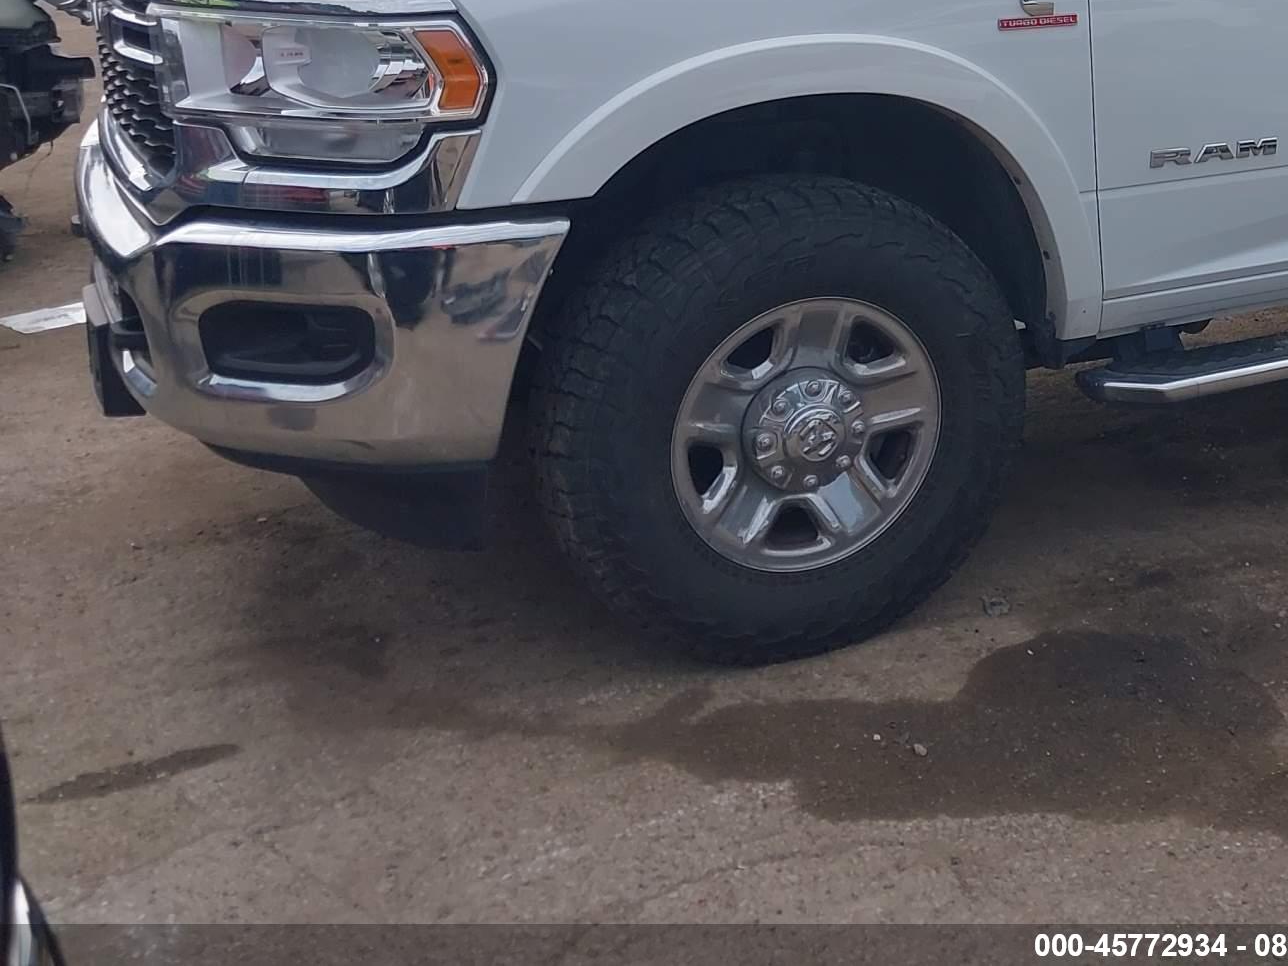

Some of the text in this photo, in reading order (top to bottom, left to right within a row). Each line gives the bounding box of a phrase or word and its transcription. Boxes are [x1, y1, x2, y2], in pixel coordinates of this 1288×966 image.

[1002, 15, 1076, 27] TURBO DIESEL
[1149, 137, 1278, 169] RAM
